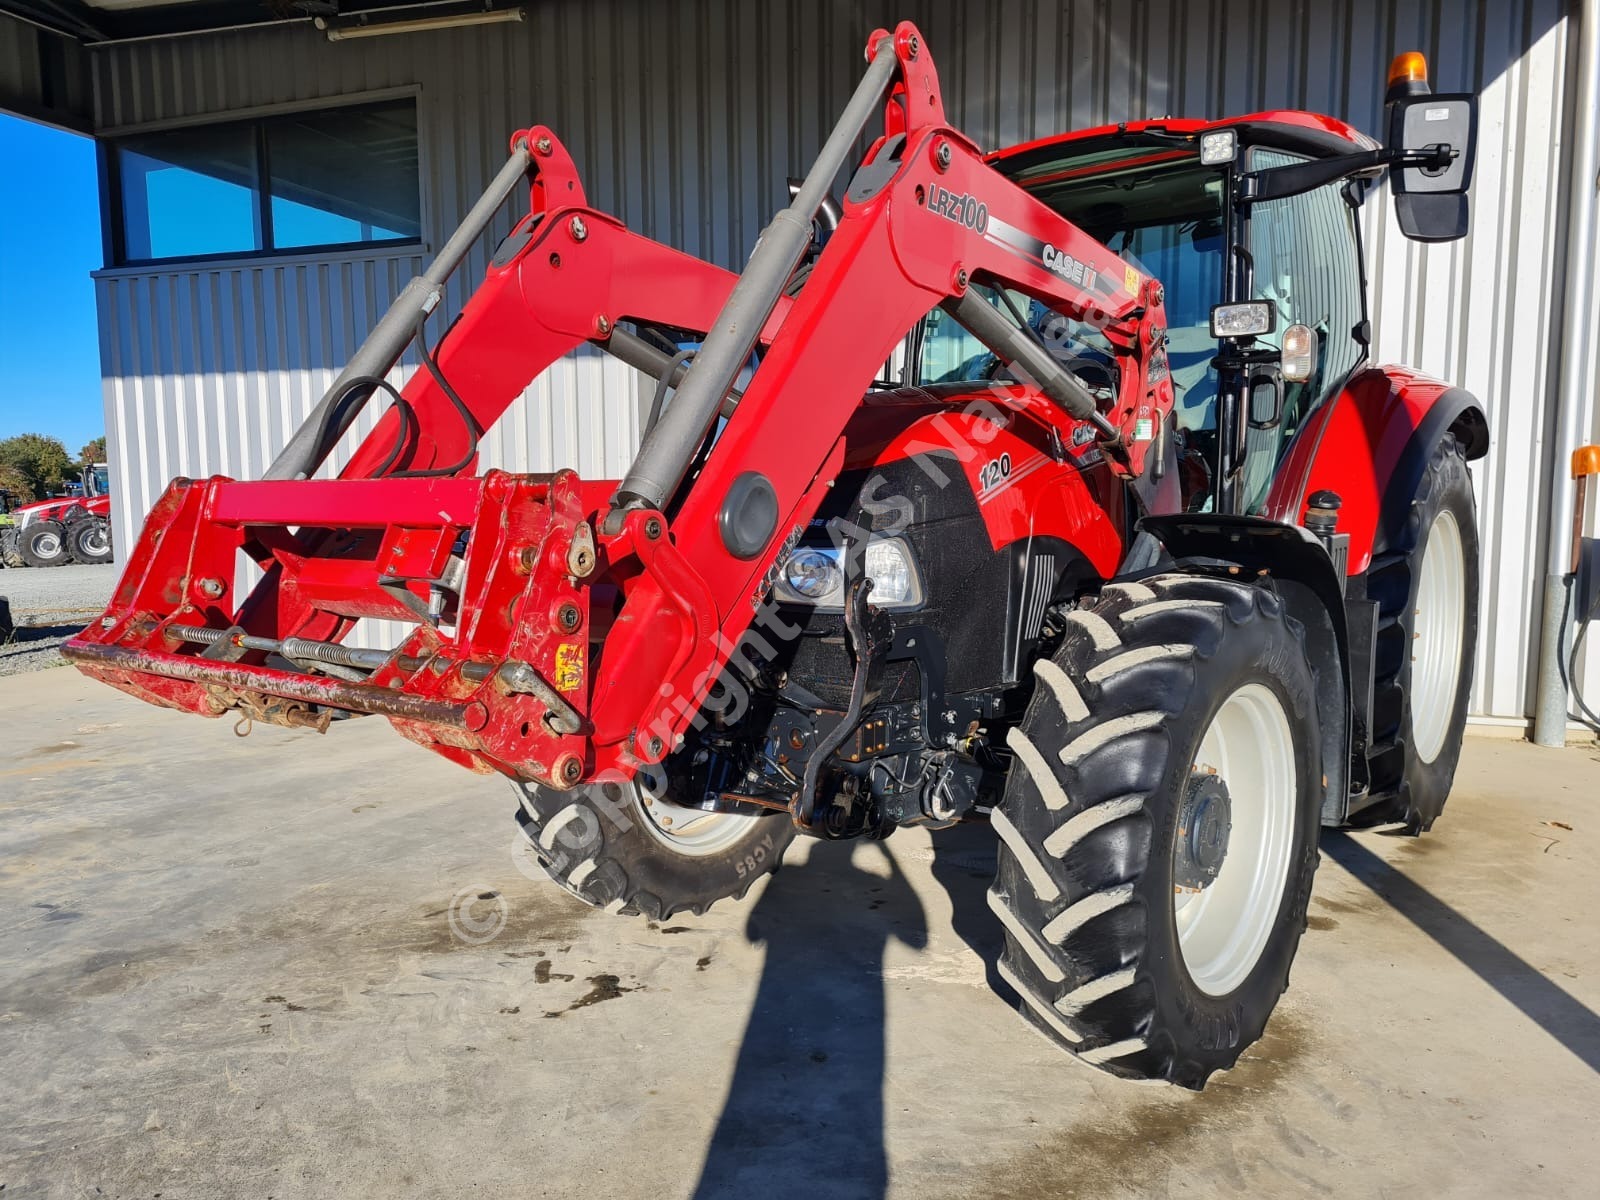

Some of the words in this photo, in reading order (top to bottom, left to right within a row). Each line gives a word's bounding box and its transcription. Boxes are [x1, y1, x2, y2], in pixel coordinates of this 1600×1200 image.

[927, 183, 990, 236] LRZ100
[1042, 244, 1084, 285] CASE
[979, 452, 1012, 491] 120
[735, 834, 774, 880] AC85
